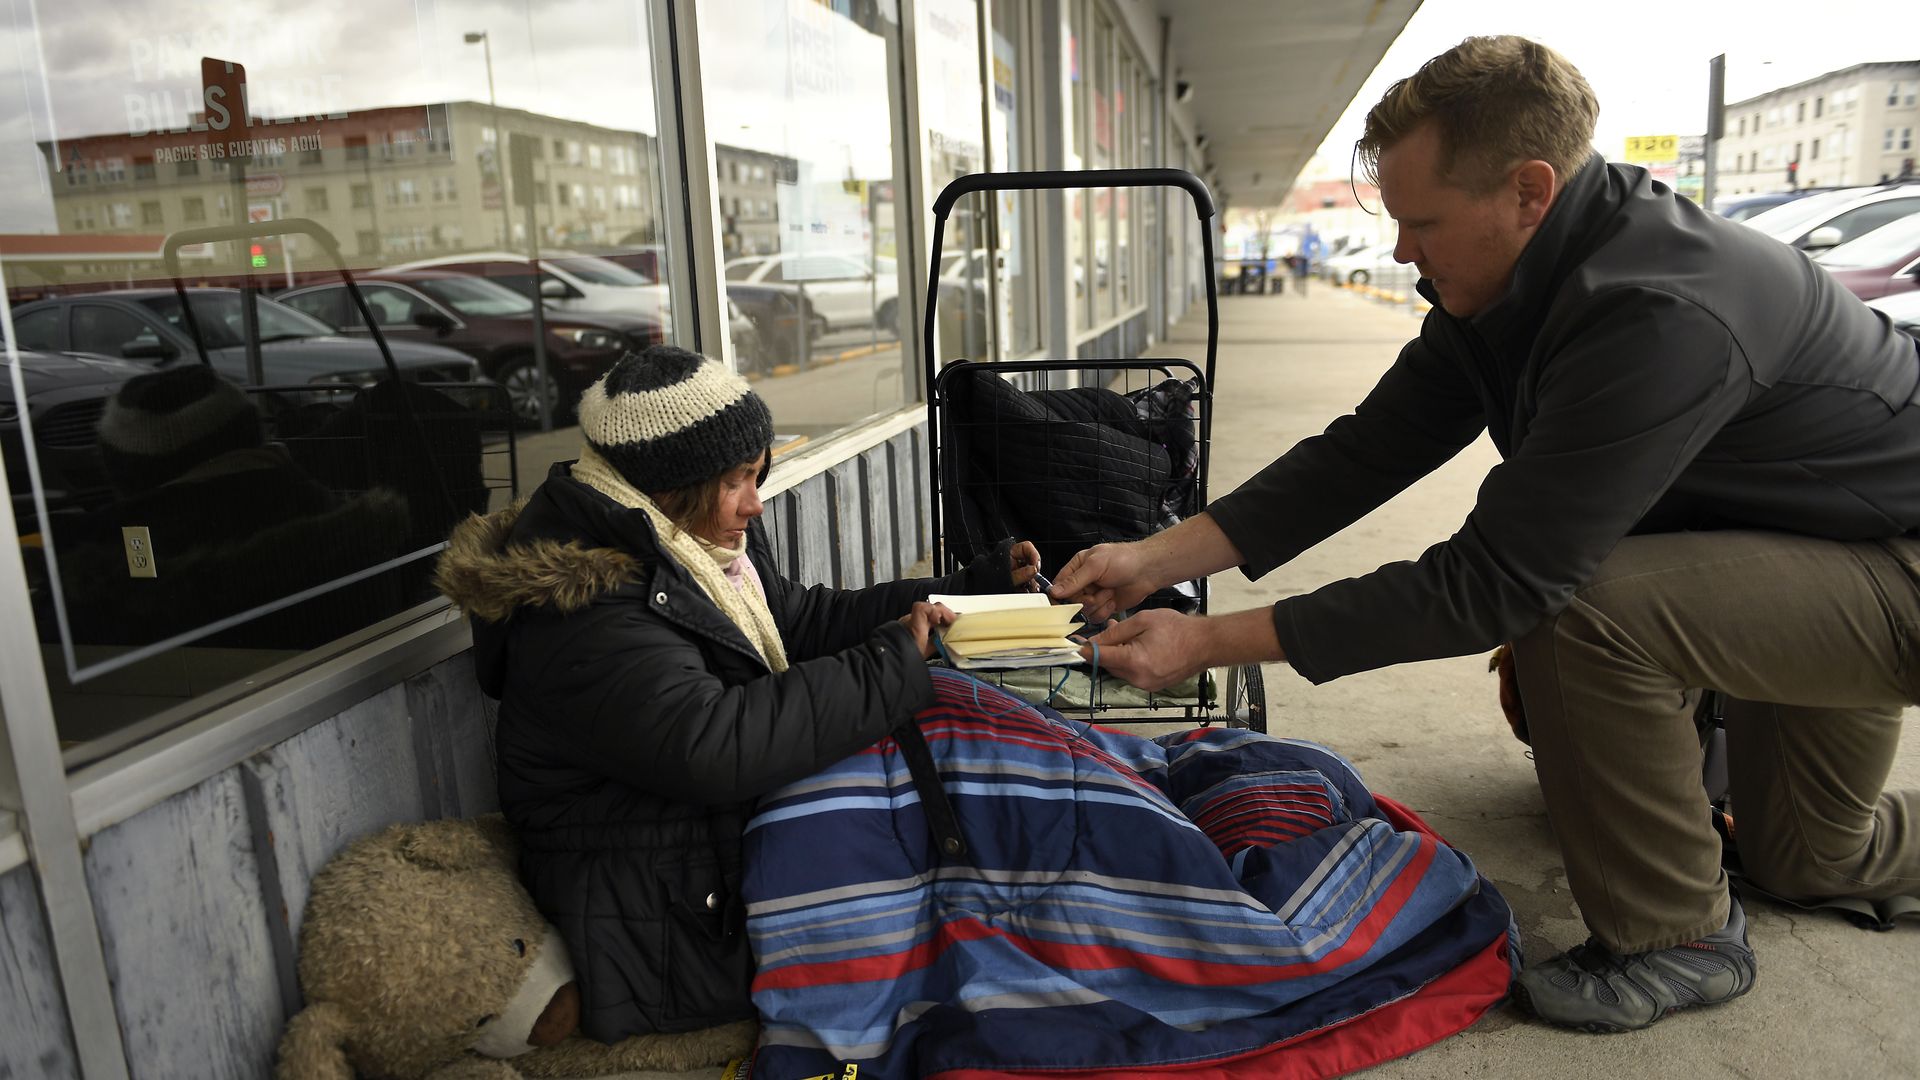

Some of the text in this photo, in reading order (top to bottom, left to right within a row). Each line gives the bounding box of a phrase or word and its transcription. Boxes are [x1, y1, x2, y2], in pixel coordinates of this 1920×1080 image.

[125, 74, 348, 136] BILLS HERE
[155, 129, 323, 164] PAGUE SUS CUENTAS AQUÍ
